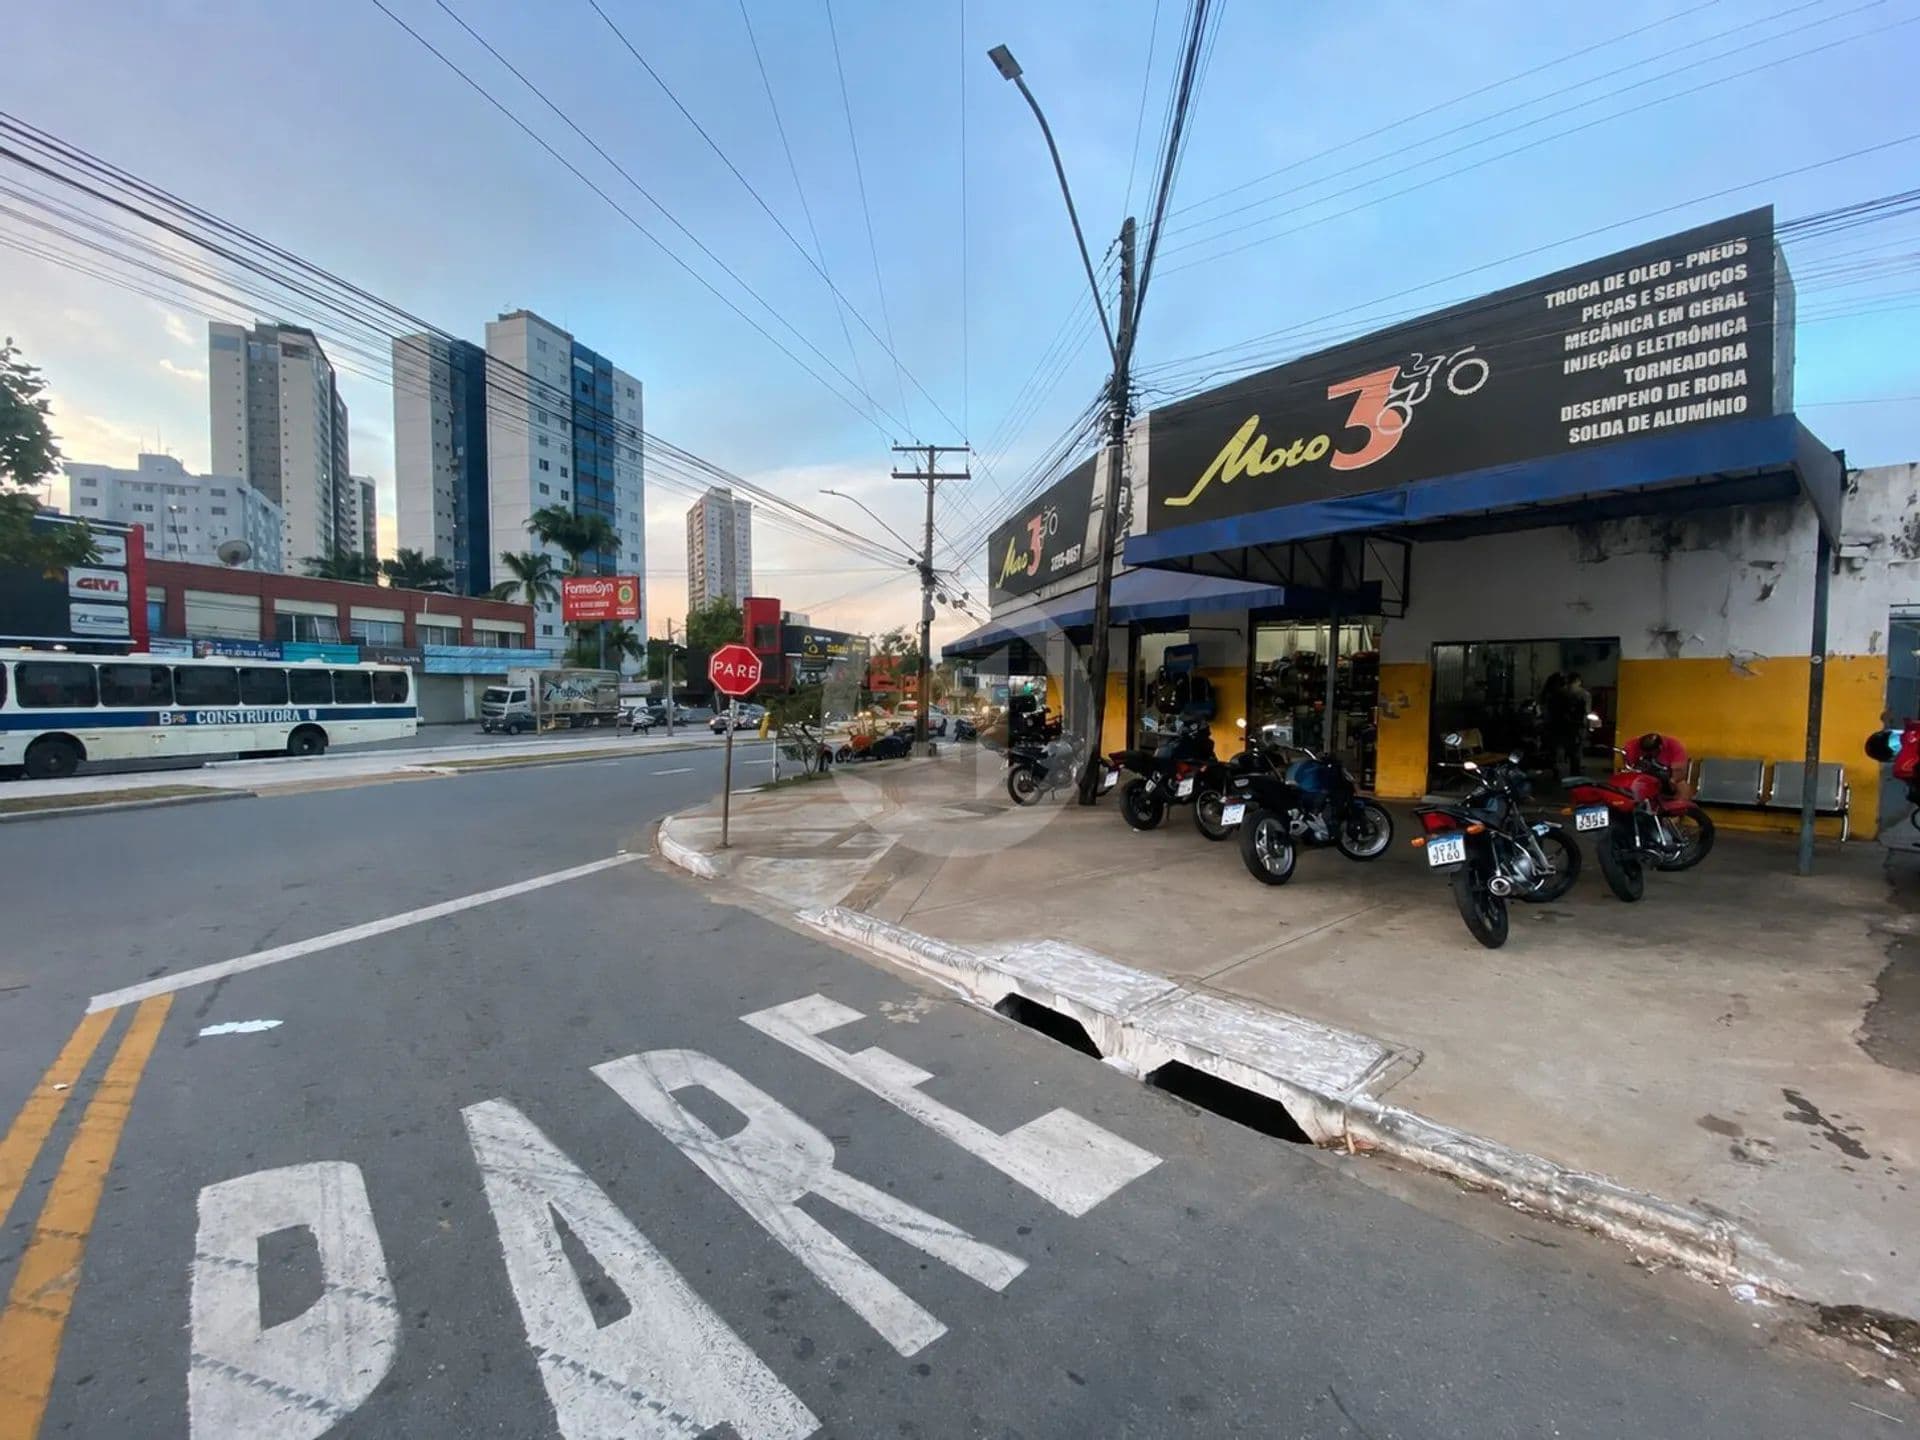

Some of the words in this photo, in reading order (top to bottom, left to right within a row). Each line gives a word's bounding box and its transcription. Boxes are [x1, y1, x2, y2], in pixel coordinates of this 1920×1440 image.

[1545, 280, 1601, 309] TROCA
[1603, 272, 1625, 293] DE
[1628, 260, 1672, 285] OLEO
[1686, 237, 1748, 269] PNEUS
[1582, 293, 1637, 323] PEÇAS
[1640, 289, 1651, 307] E
[1654, 263, 1748, 303] SERVIÇOS
[1563, 343, 1633, 375] INJEÇÃO
[1636, 316, 1748, 358] ELETRÔNICA
[1564, 313, 1654, 351] MECÂNICA
[1658, 305, 1684, 327] EM
[1688, 291, 1748, 319] GERAL
[1624, 342, 1748, 384] TORNEADORA
[1560, 386, 1663, 422] DESEMPENO
[1667, 380, 1691, 400] DE
[1568, 417, 1624, 444] SOLDA
[1628, 413, 1650, 433] DE
[1653, 395, 1748, 428] ALUMÍNIO
[1164, 414, 1330, 506] Moto
[713, 660, 758, 680] PARE
[196, 709, 300, 725] CONSTRUTORA
[187, 992, 1163, 1440] PARE
